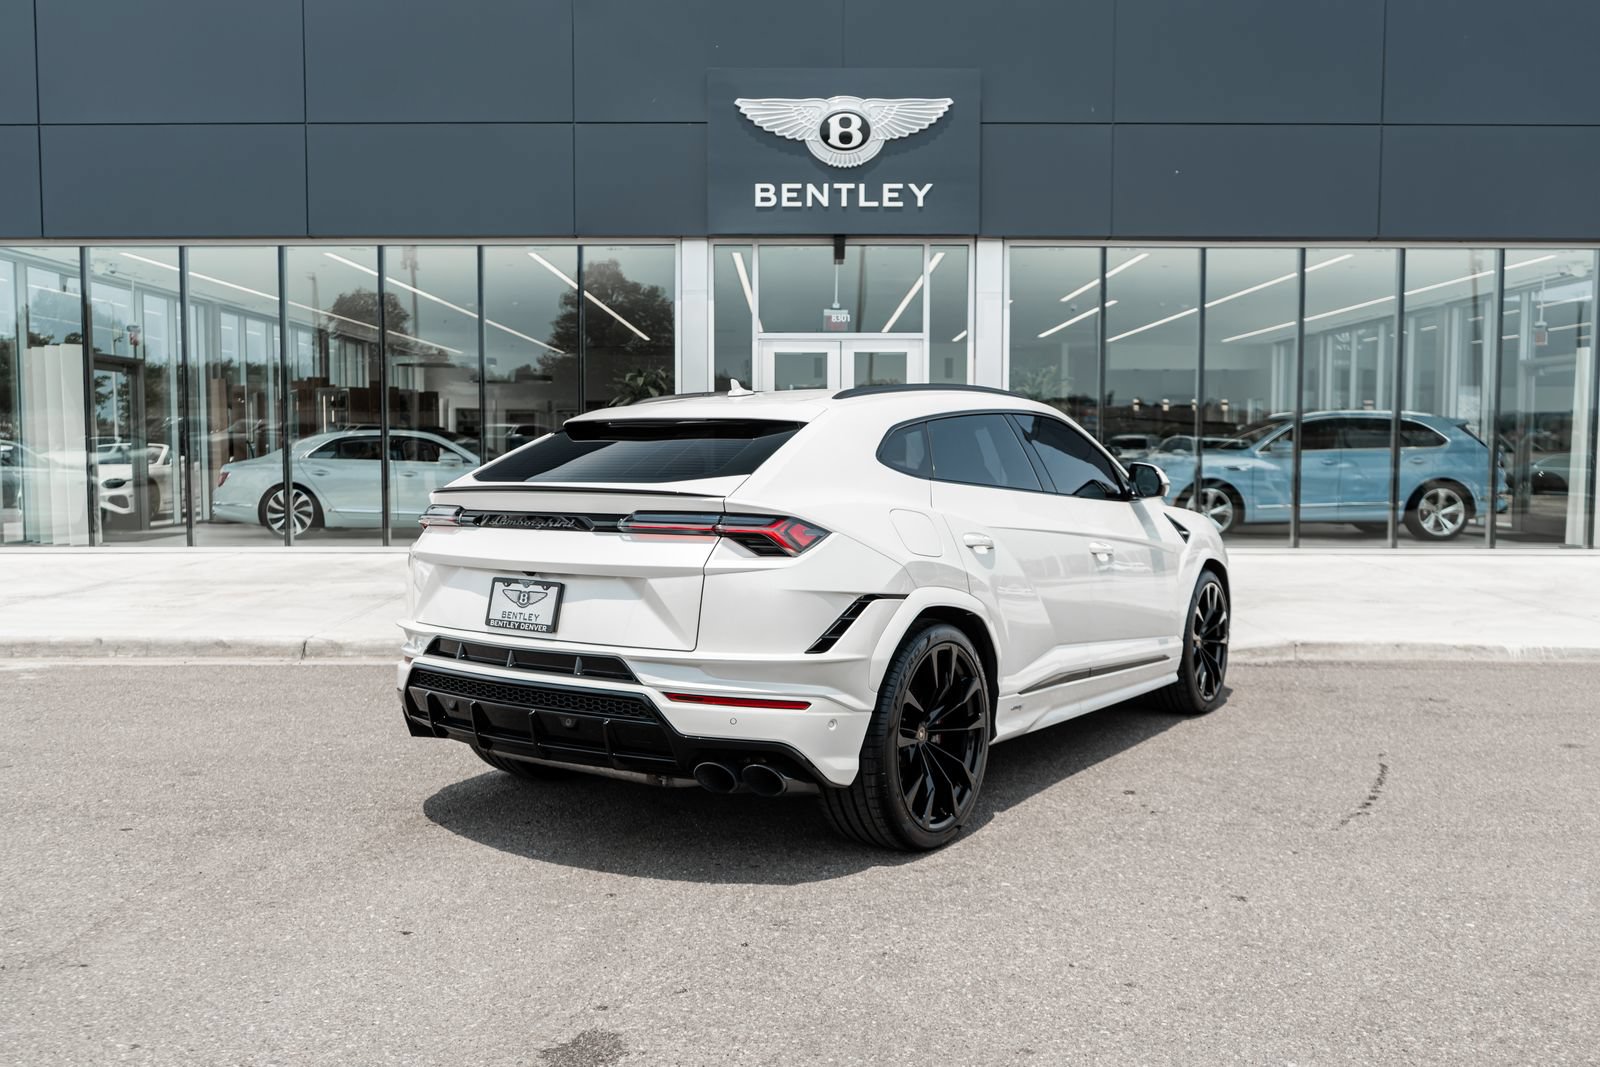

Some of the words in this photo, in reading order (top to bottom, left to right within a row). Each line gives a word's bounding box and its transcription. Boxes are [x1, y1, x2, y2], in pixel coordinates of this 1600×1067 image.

[828, 113, 863, 149] B
[754, 183, 933, 207] BENTLEY
[831, 314, 850, 322] 8301
[489, 514, 574, 528] Lamborghini
[501, 611, 540, 622] BENTLEY
[490, 619, 519, 629] BENTLEY
[520, 623, 547, 632] DENVER
